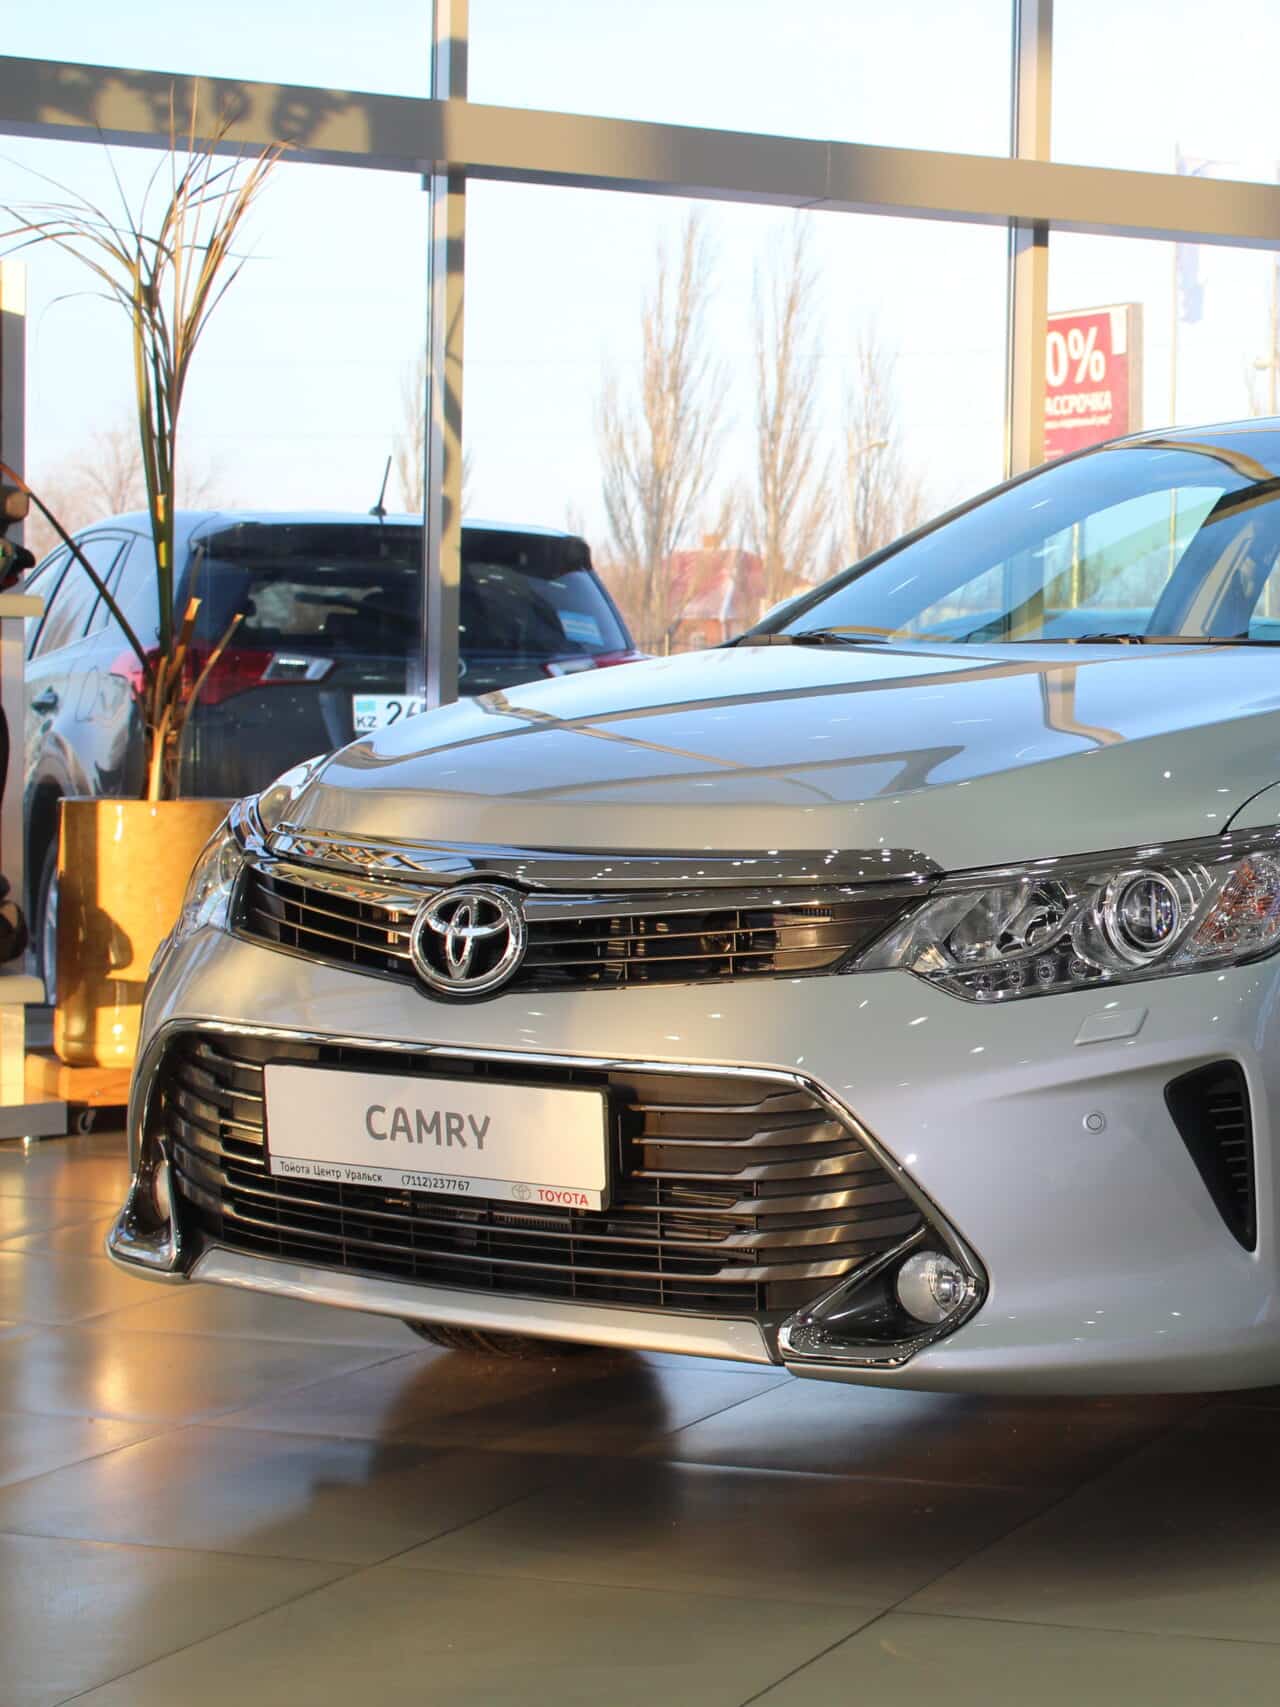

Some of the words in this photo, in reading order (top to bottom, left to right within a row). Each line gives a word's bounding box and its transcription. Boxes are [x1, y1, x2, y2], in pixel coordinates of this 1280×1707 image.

[356, 716, 377, 728] KZ
[365, 1104, 491, 1150] CAMRY
[280, 1161, 310, 1175] Тойота
[313, 1164, 342, 1179] Центр
[345, 1166, 383, 1184] Уральск
[537, 1189, 589, 1207] TOYOTA
